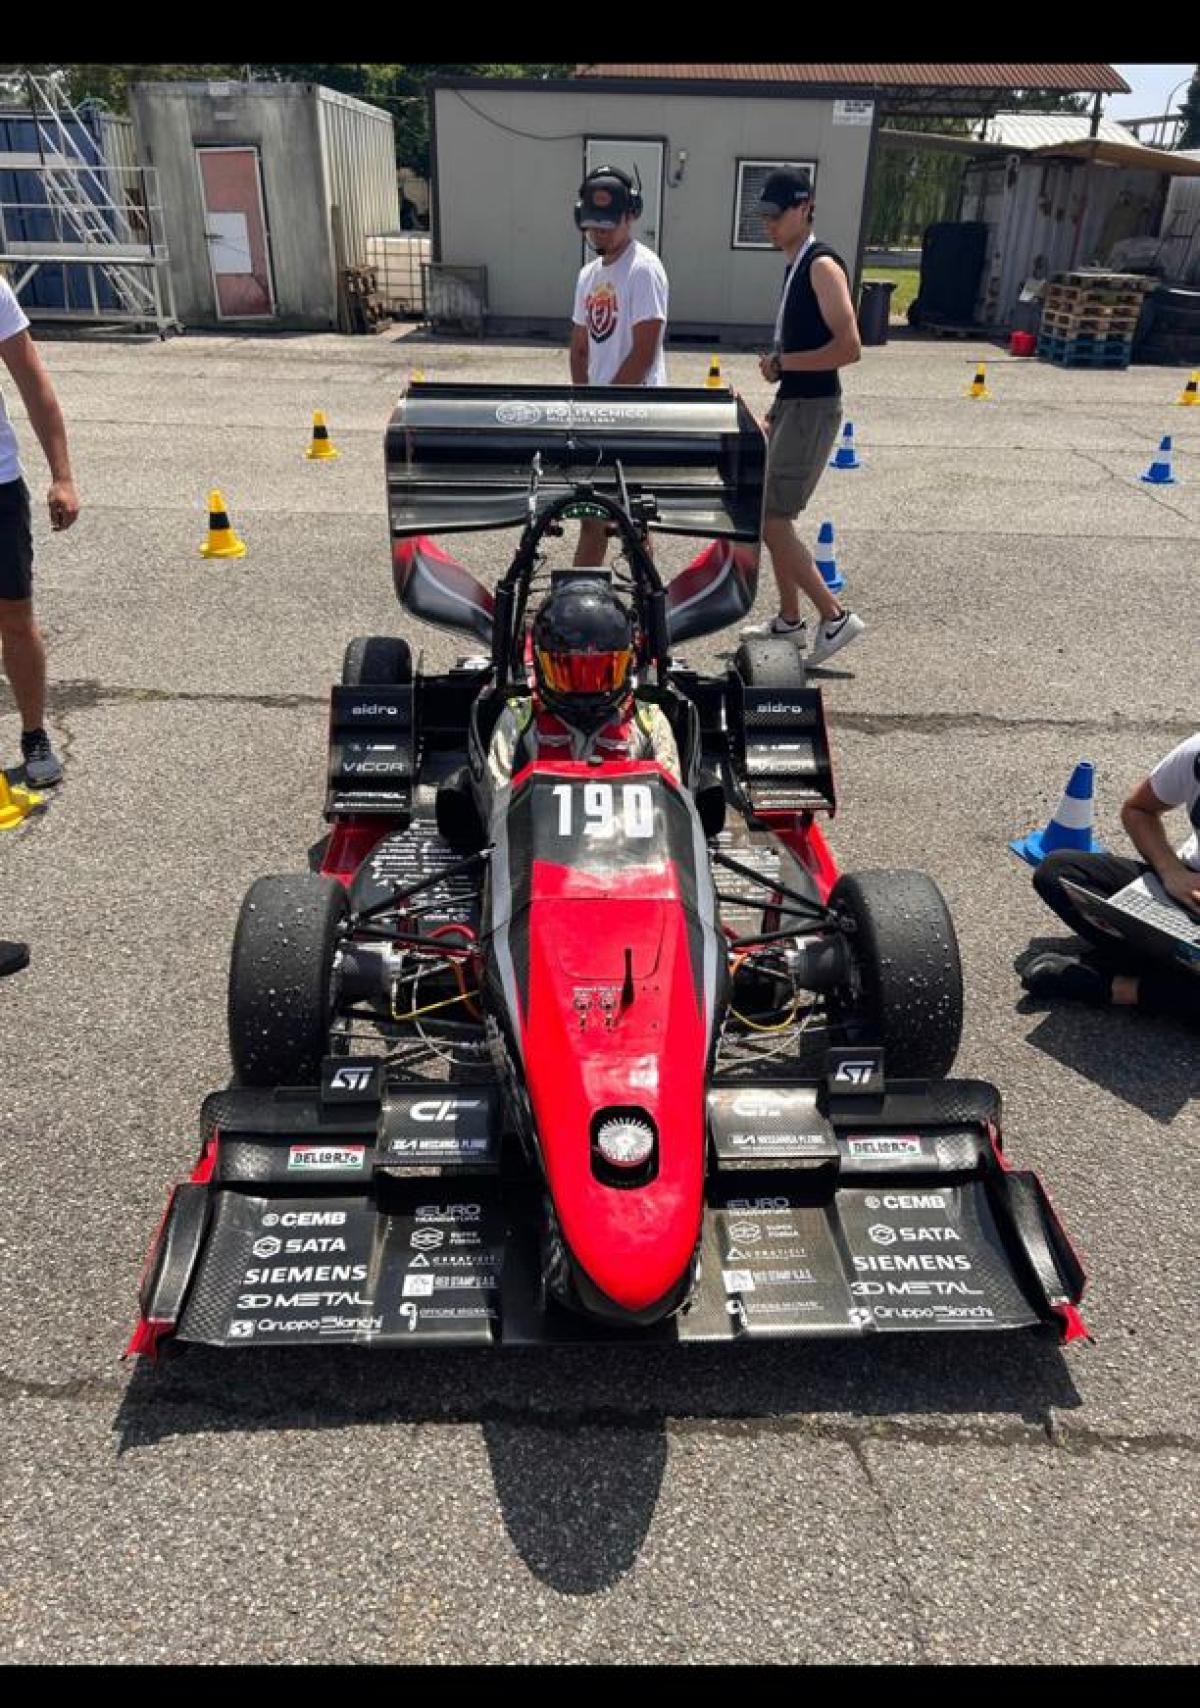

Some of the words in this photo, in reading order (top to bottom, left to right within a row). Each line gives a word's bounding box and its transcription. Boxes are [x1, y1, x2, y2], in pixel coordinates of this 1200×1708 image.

[552, 783, 655, 838] 190
[883, 1195, 945, 1209] CEMB
[281, 1211, 346, 1227] CEMB
[900, 1227, 961, 1241] SATA
[285, 1237, 346, 1254] SATA
[852, 1255, 972, 1271] SIEMENS
[243, 1264, 368, 1285] SIEMENS
